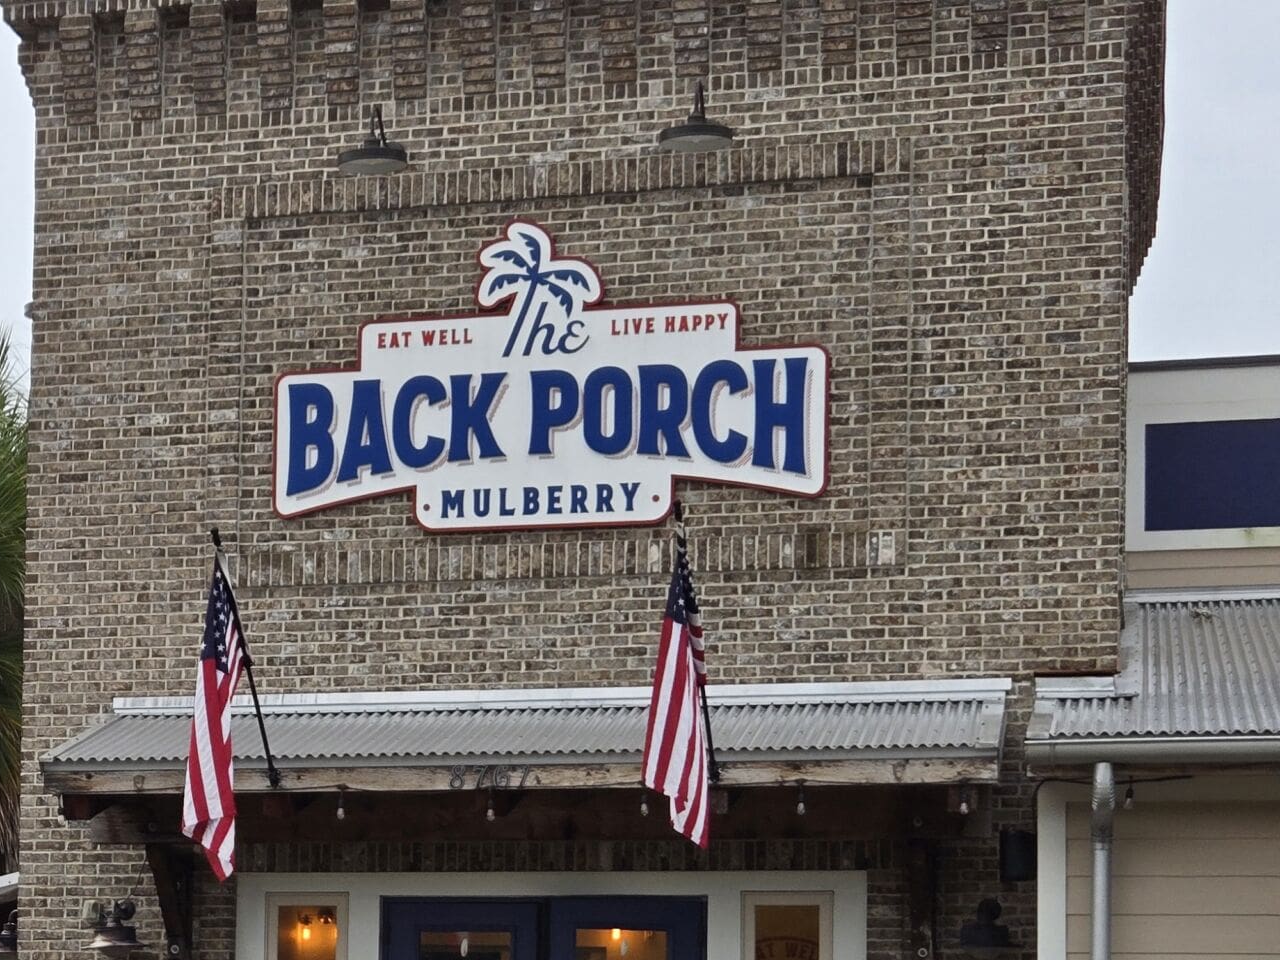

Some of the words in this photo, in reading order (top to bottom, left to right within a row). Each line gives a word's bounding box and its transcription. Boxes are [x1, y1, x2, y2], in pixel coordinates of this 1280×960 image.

[502, 276, 590, 358] The
[611, 318, 655, 336] LIVE
[664, 313, 729, 333] HAPPY
[377, 331, 412, 349] EAT
[421, 328, 473, 347] WELL
[286, 371, 509, 498] BACK
[528, 356, 810, 477] PORCH
[439, 482, 641, 519] MULBERRY
[448, 764, 529, 790] 8767
